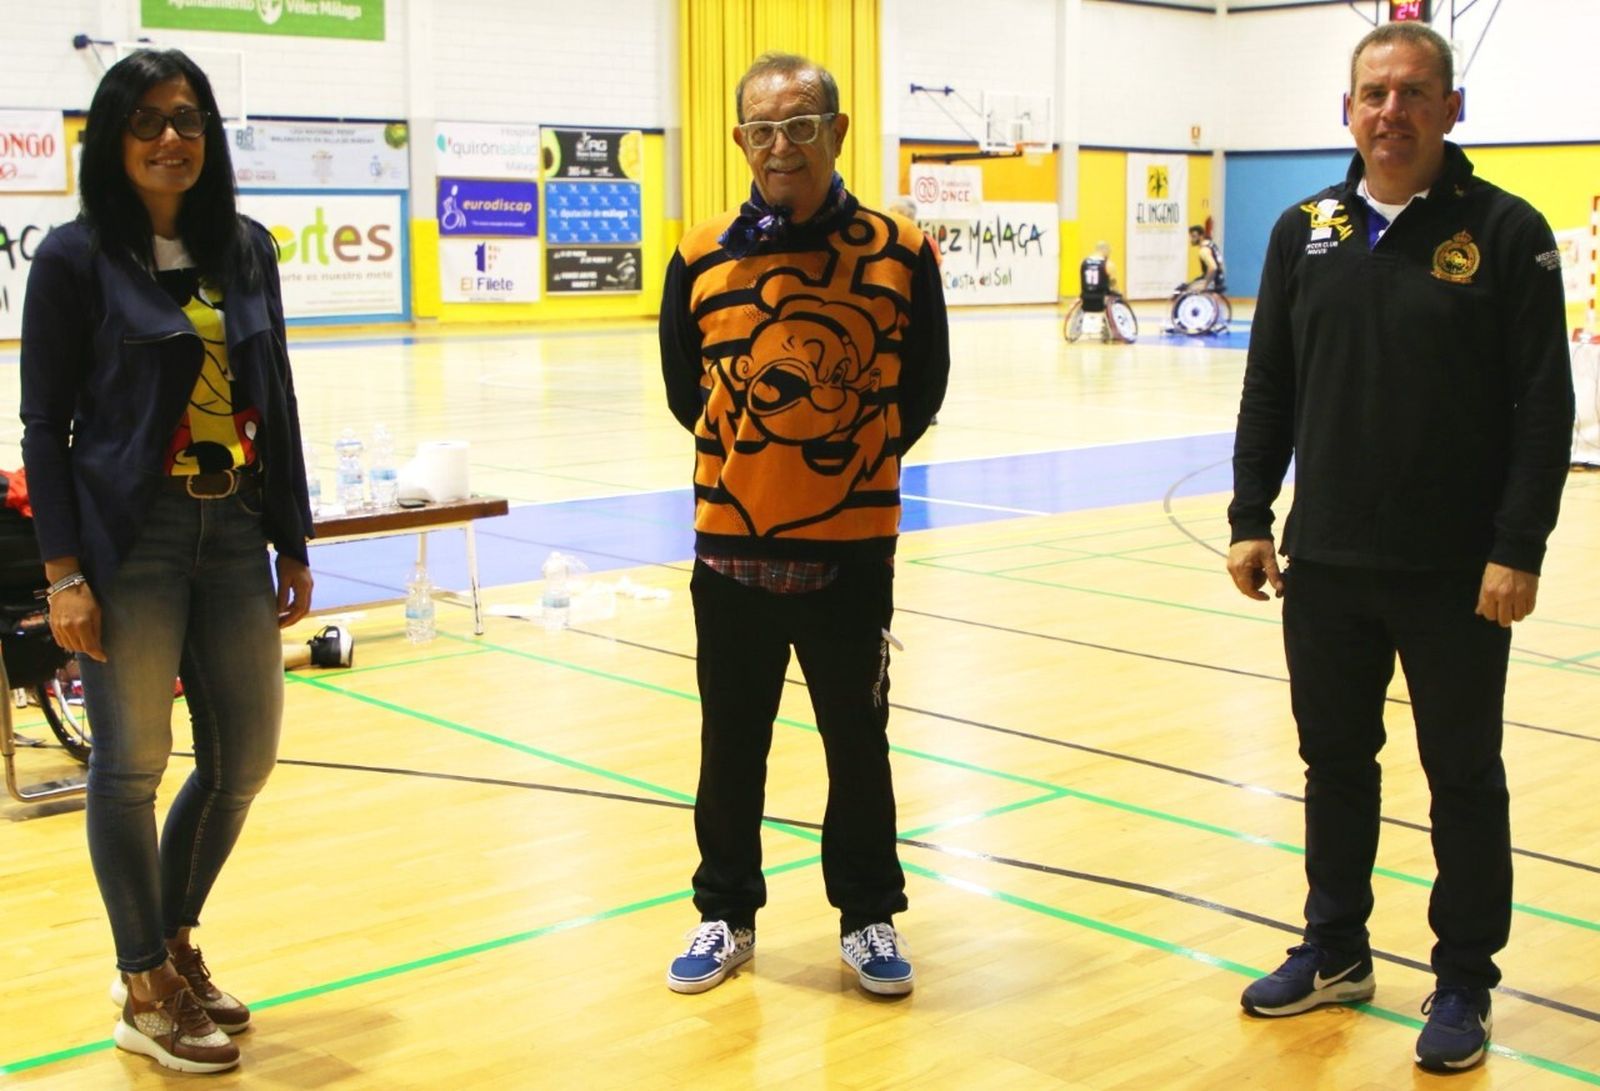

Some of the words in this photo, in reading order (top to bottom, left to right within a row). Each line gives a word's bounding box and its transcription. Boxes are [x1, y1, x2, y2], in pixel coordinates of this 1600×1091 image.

[1397, 3, 1419, 19] 24
[941, 190, 971, 202] ONCE
[462, 199, 532, 214] eurodiscap
